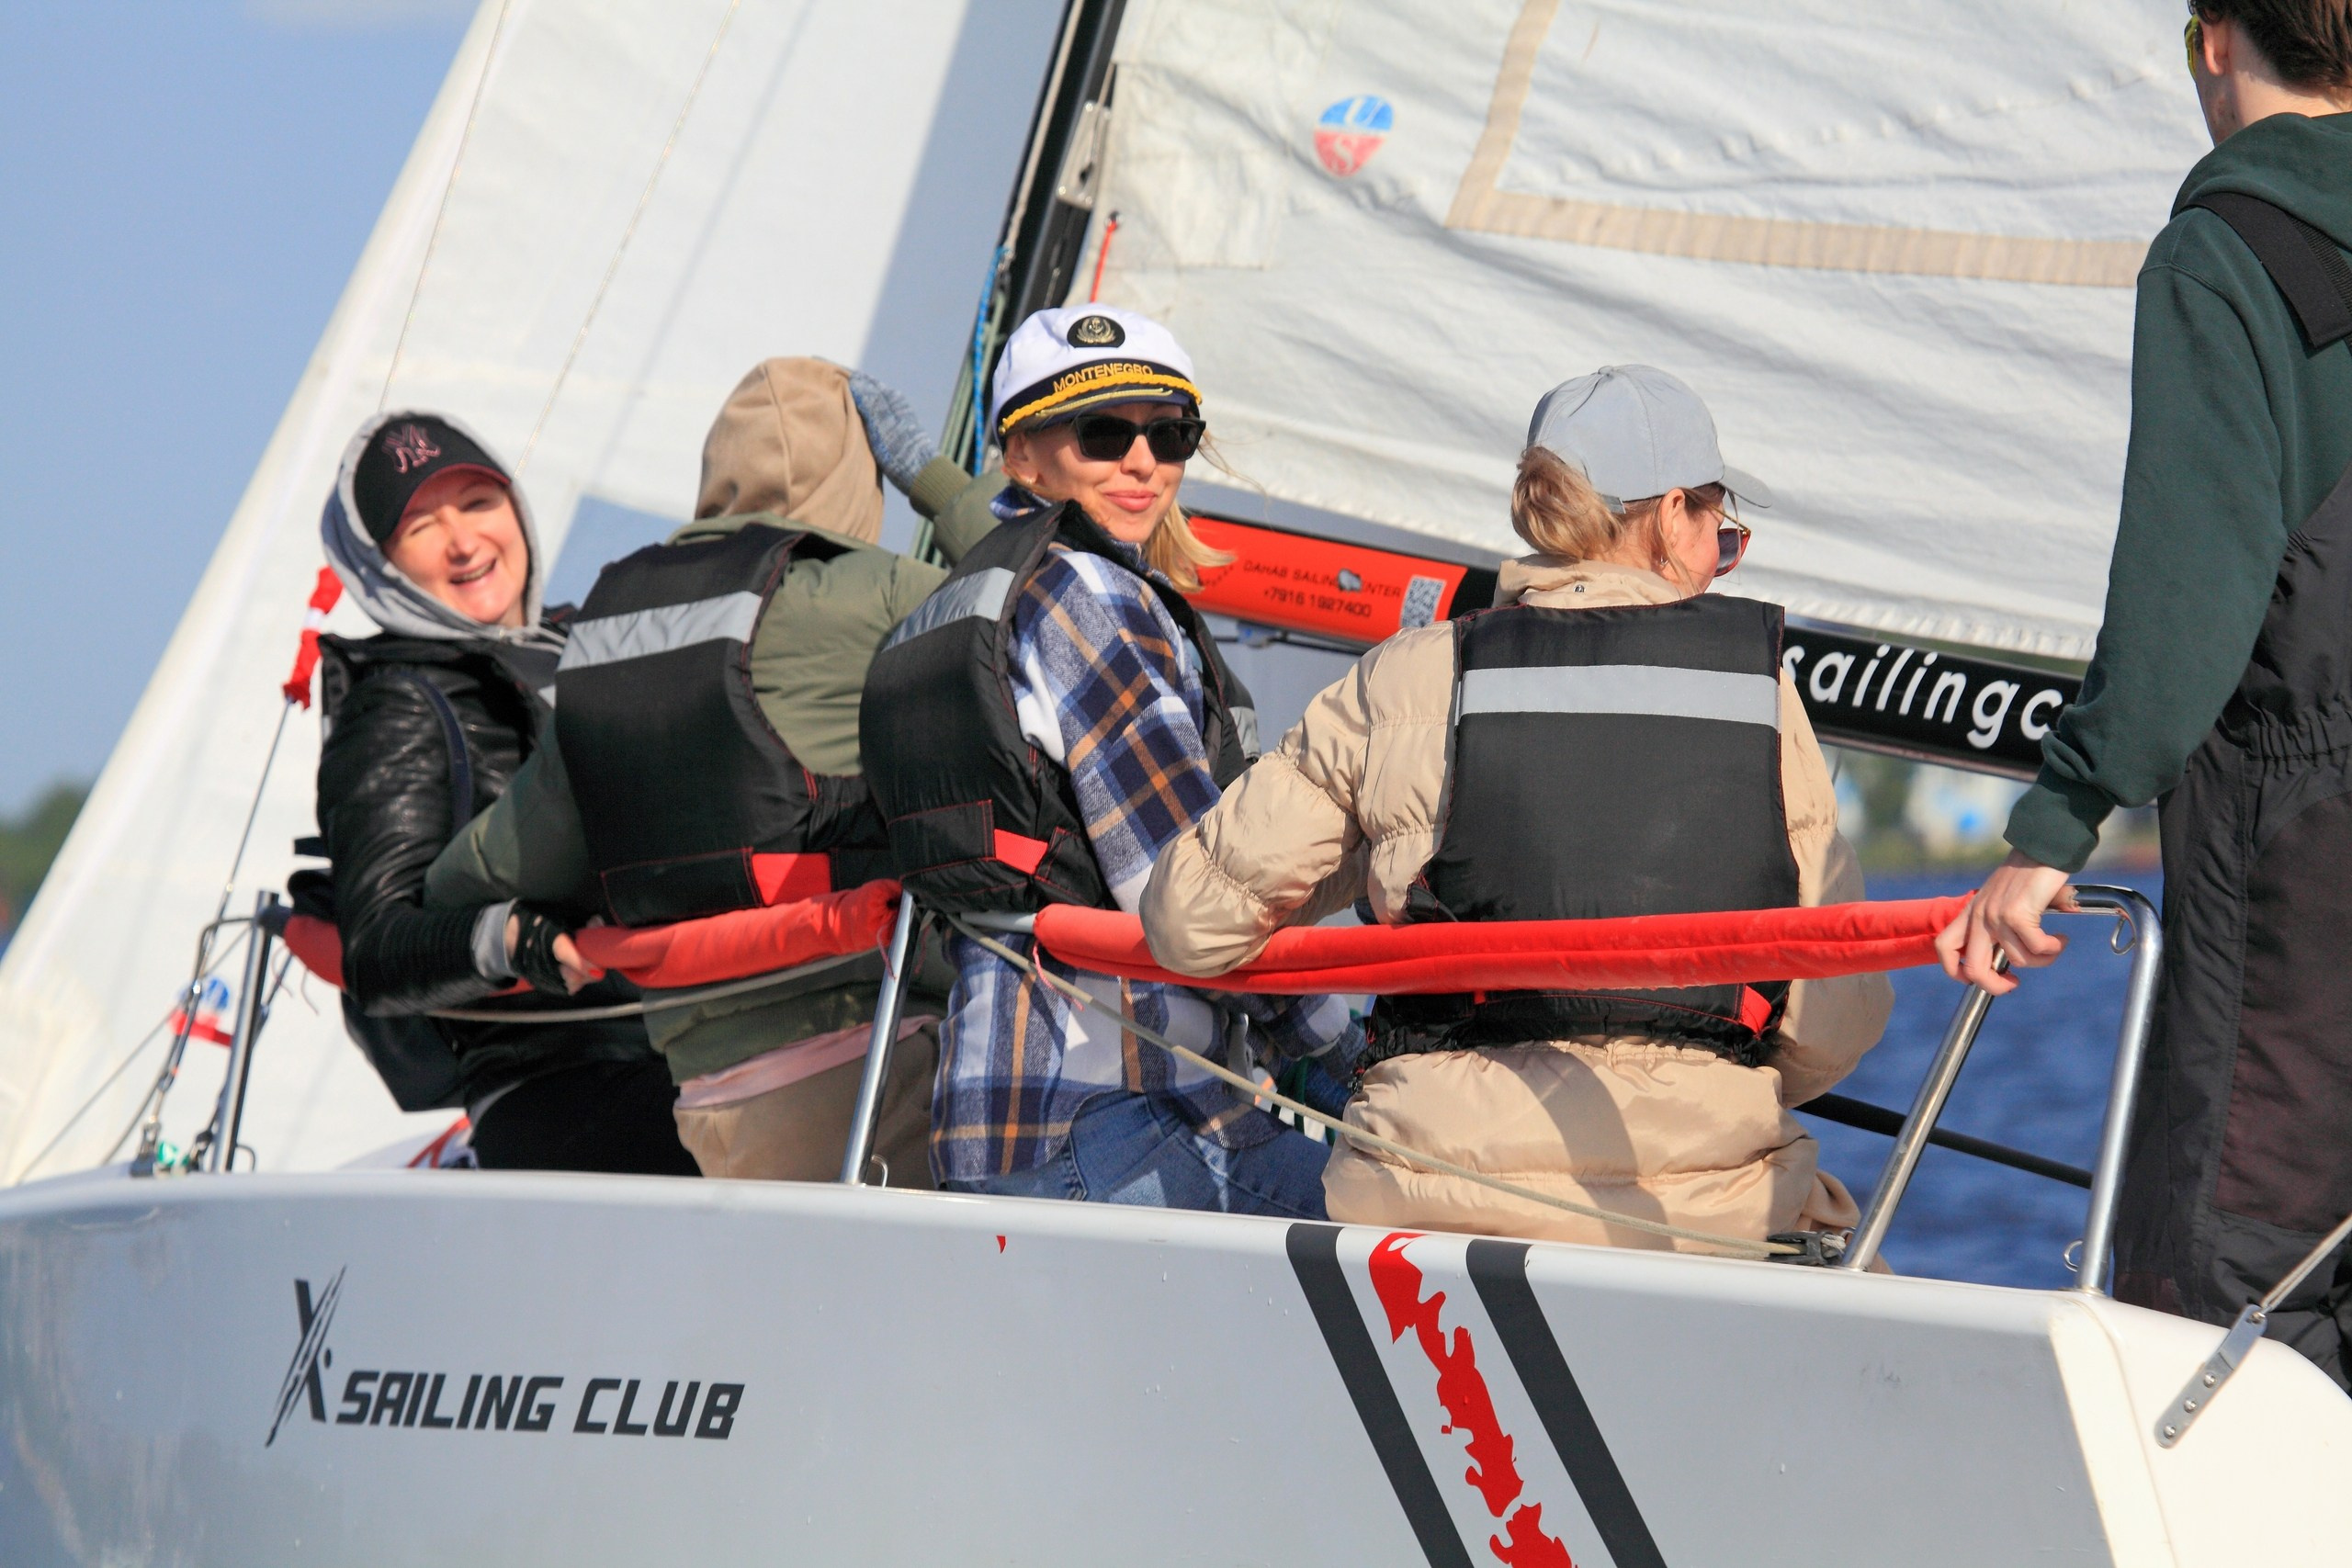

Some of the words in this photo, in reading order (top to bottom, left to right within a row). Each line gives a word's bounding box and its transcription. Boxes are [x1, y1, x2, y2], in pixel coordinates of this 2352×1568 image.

[1053, 362, 1154, 393] MONTENEGRO
[1293, 569, 1340, 589] SAILIN
[335, 1370, 565, 1433] SAILING
[572, 1378, 746, 1440] CLUB
